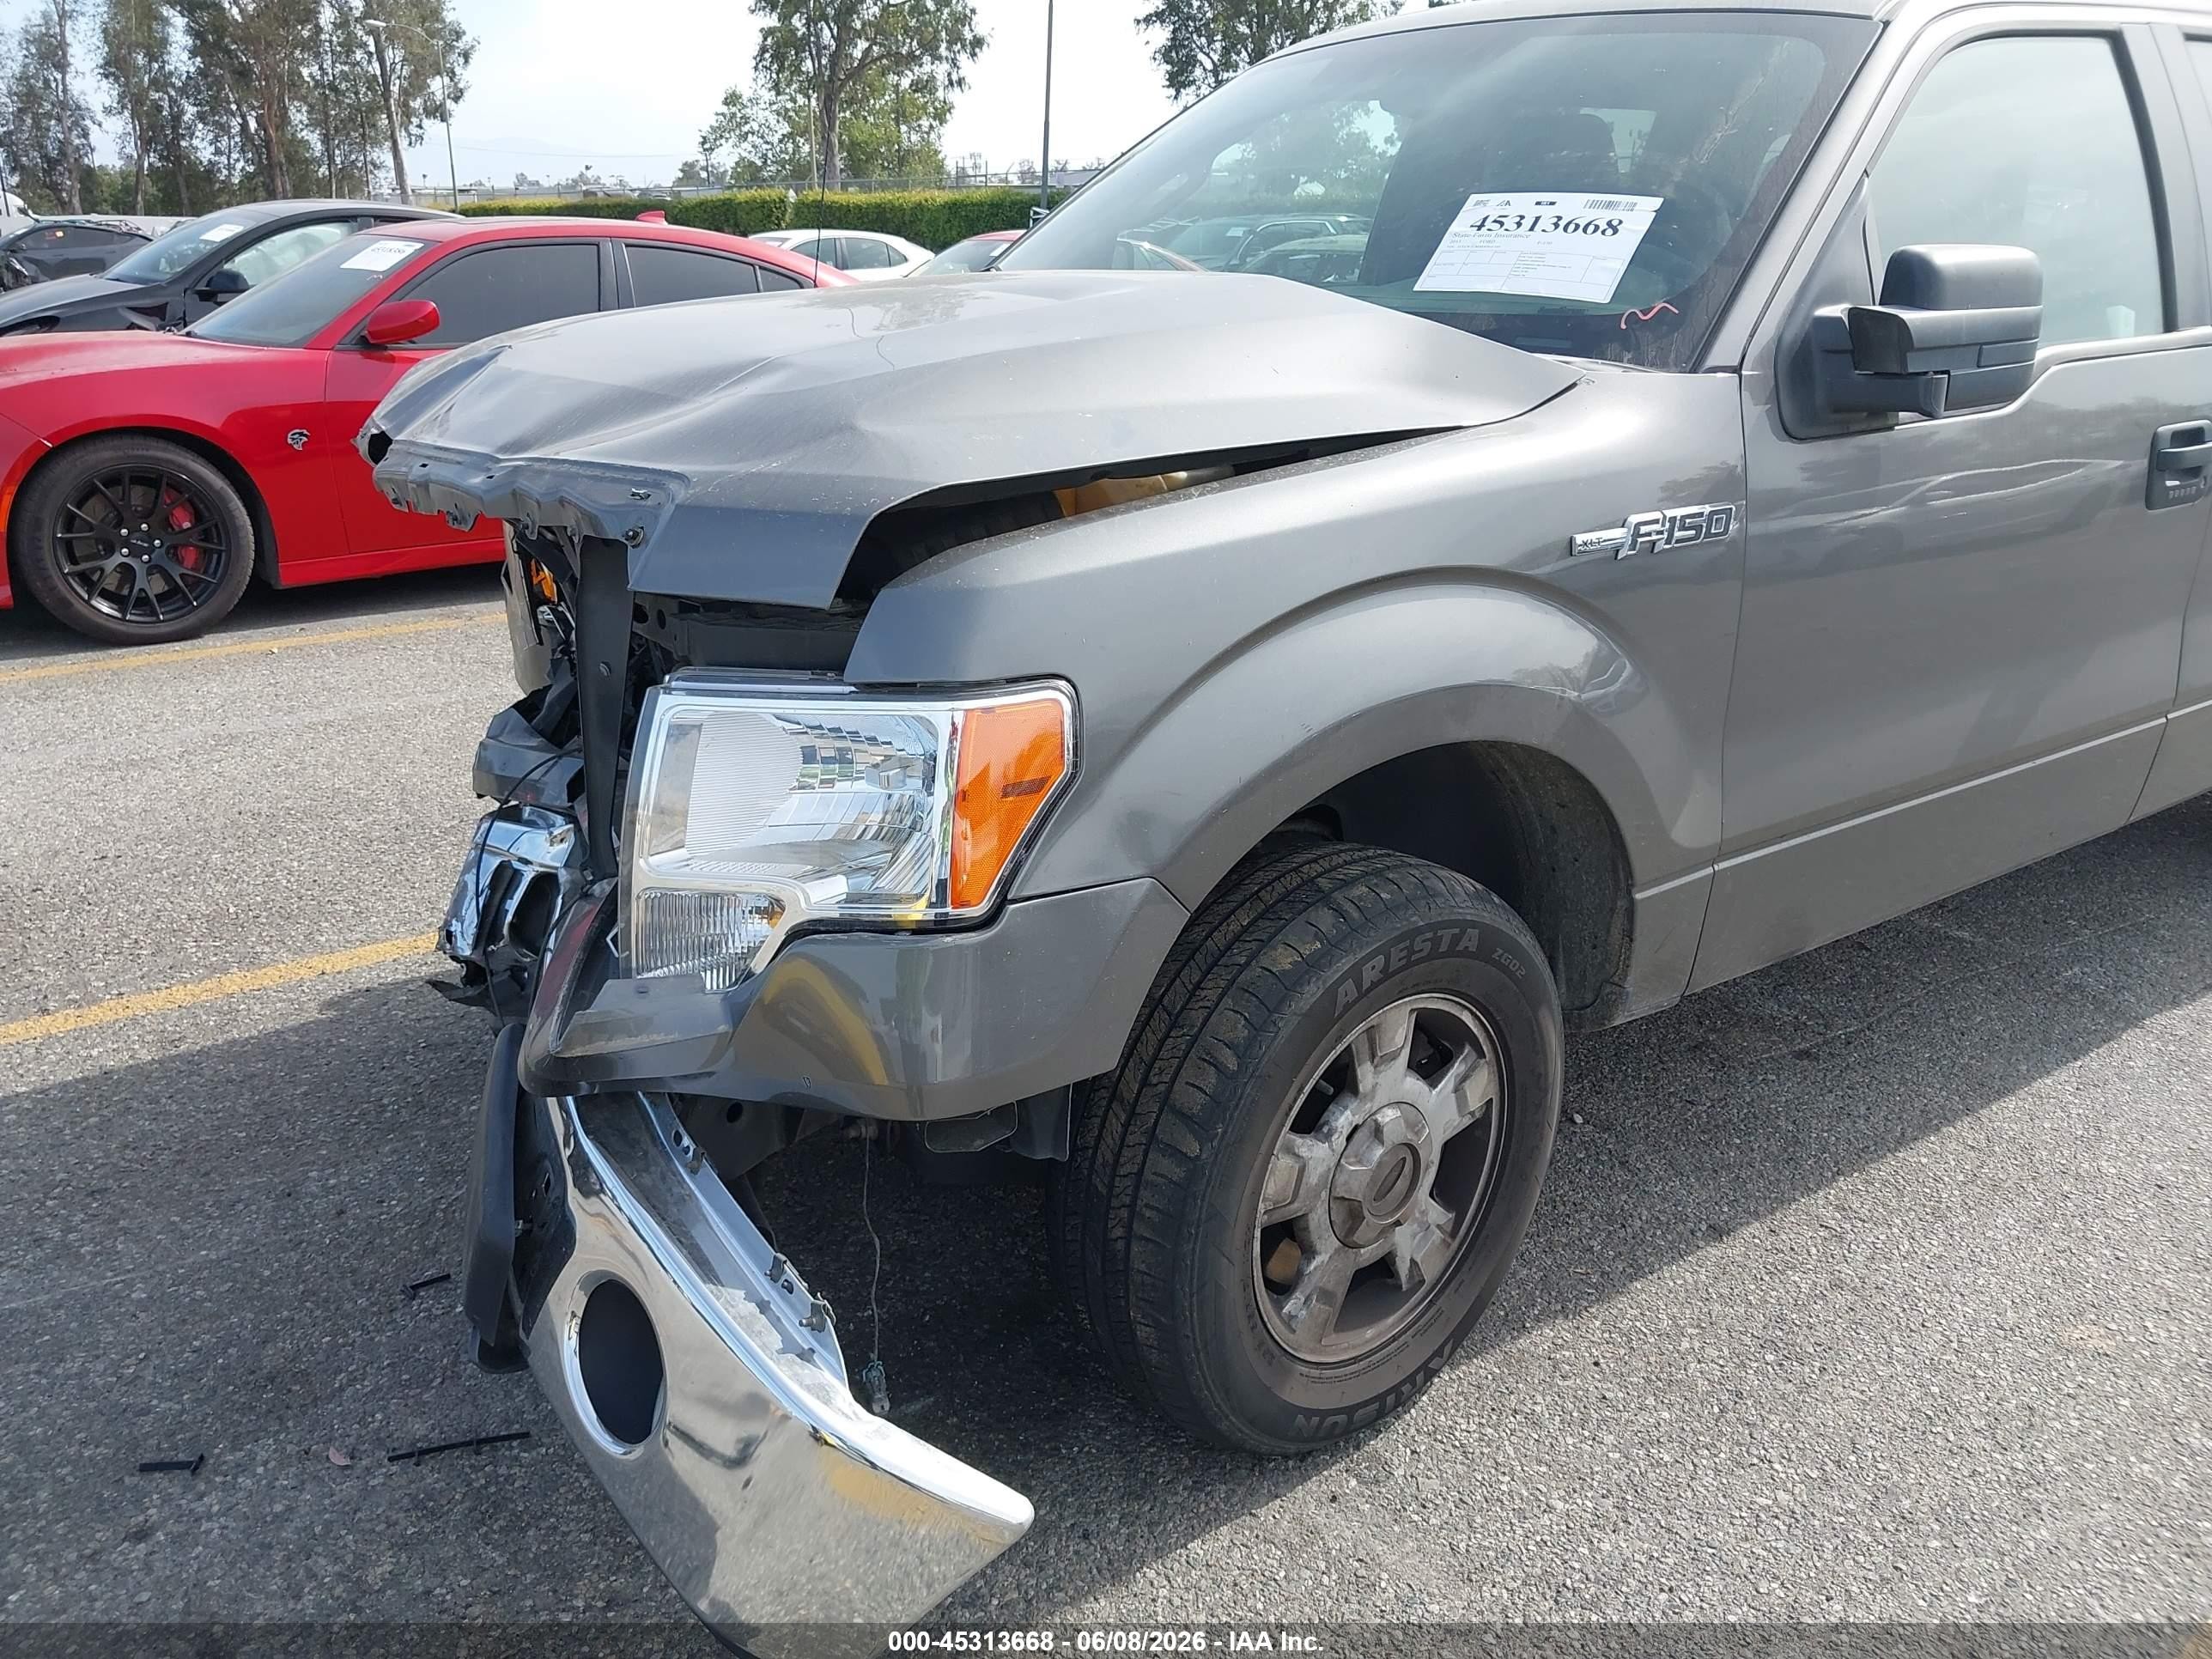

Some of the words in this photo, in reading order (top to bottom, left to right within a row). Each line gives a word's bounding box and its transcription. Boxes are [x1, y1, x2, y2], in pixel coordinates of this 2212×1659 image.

[1469, 214, 1624, 237] 45313668
[1582, 537, 1603, 550] XLT
[1334, 928, 1480, 1017] ARESTA
[1491, 947, 1527, 979] ZG02
